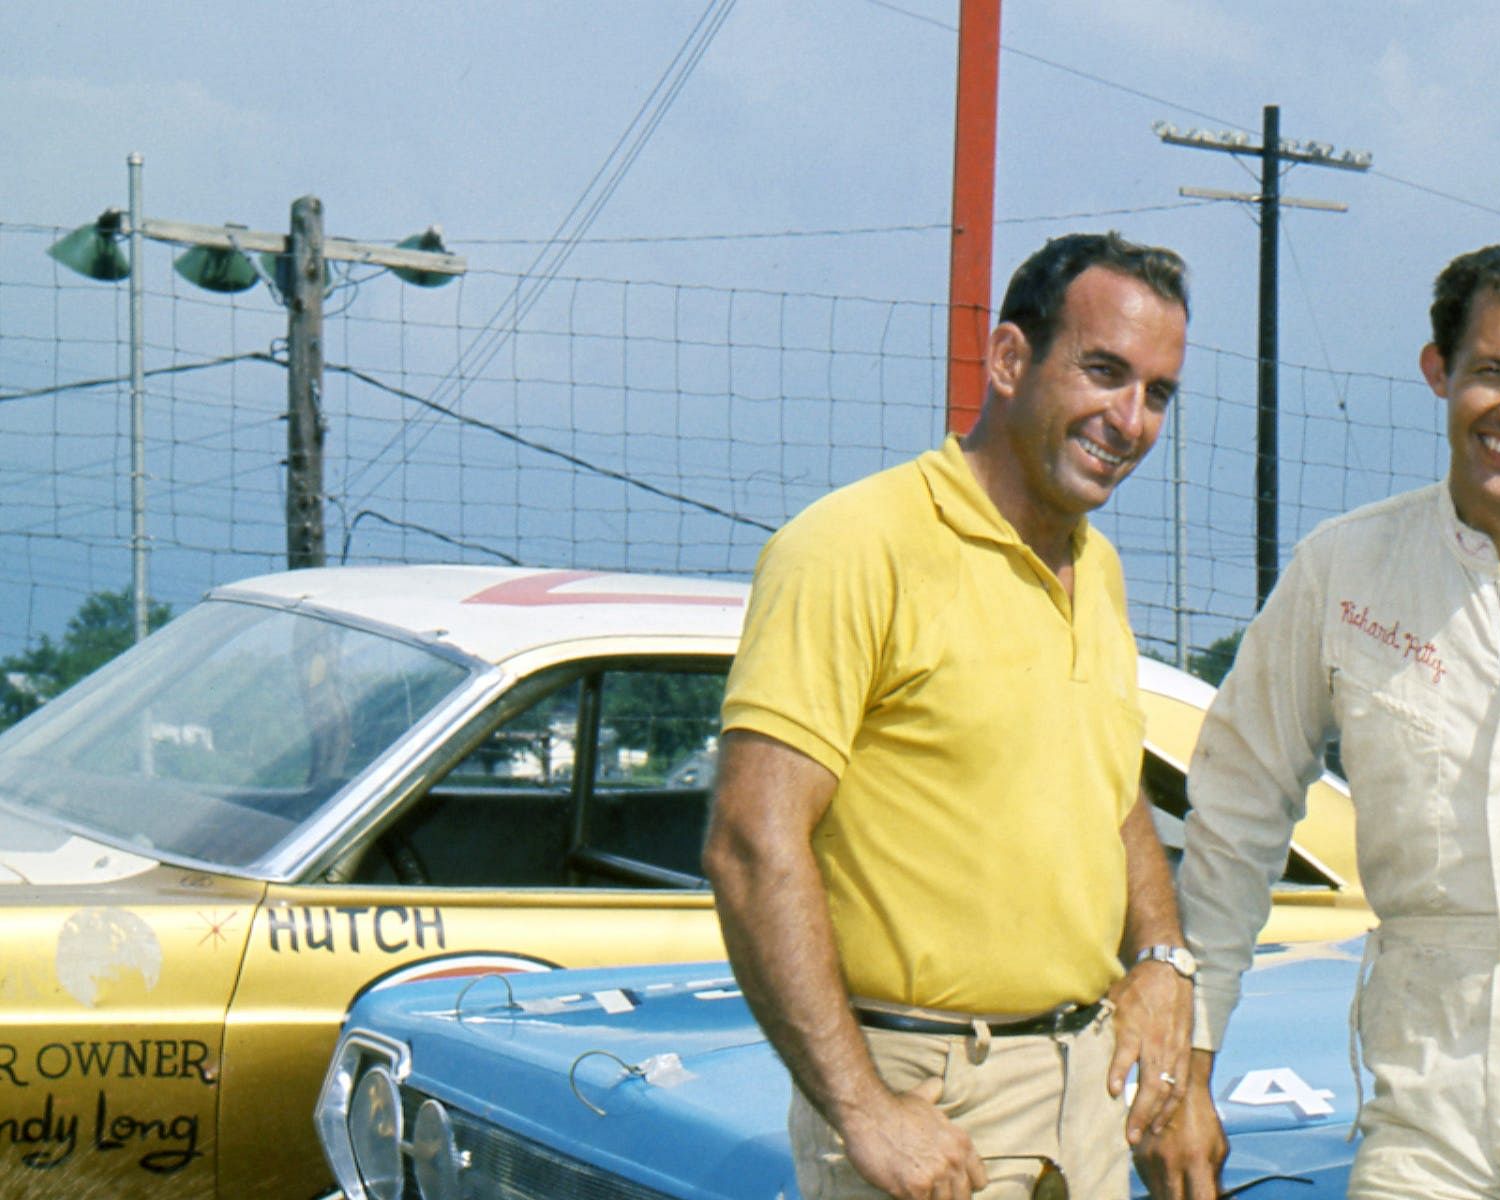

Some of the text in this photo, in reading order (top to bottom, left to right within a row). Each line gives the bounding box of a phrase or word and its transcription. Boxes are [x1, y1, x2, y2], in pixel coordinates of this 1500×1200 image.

[1340, 601, 1447, 684] Richard Petty
[268, 905, 446, 953] HUTCH
[37, 1039, 217, 1084] OWNER
[96, 1089, 203, 1174] Long
